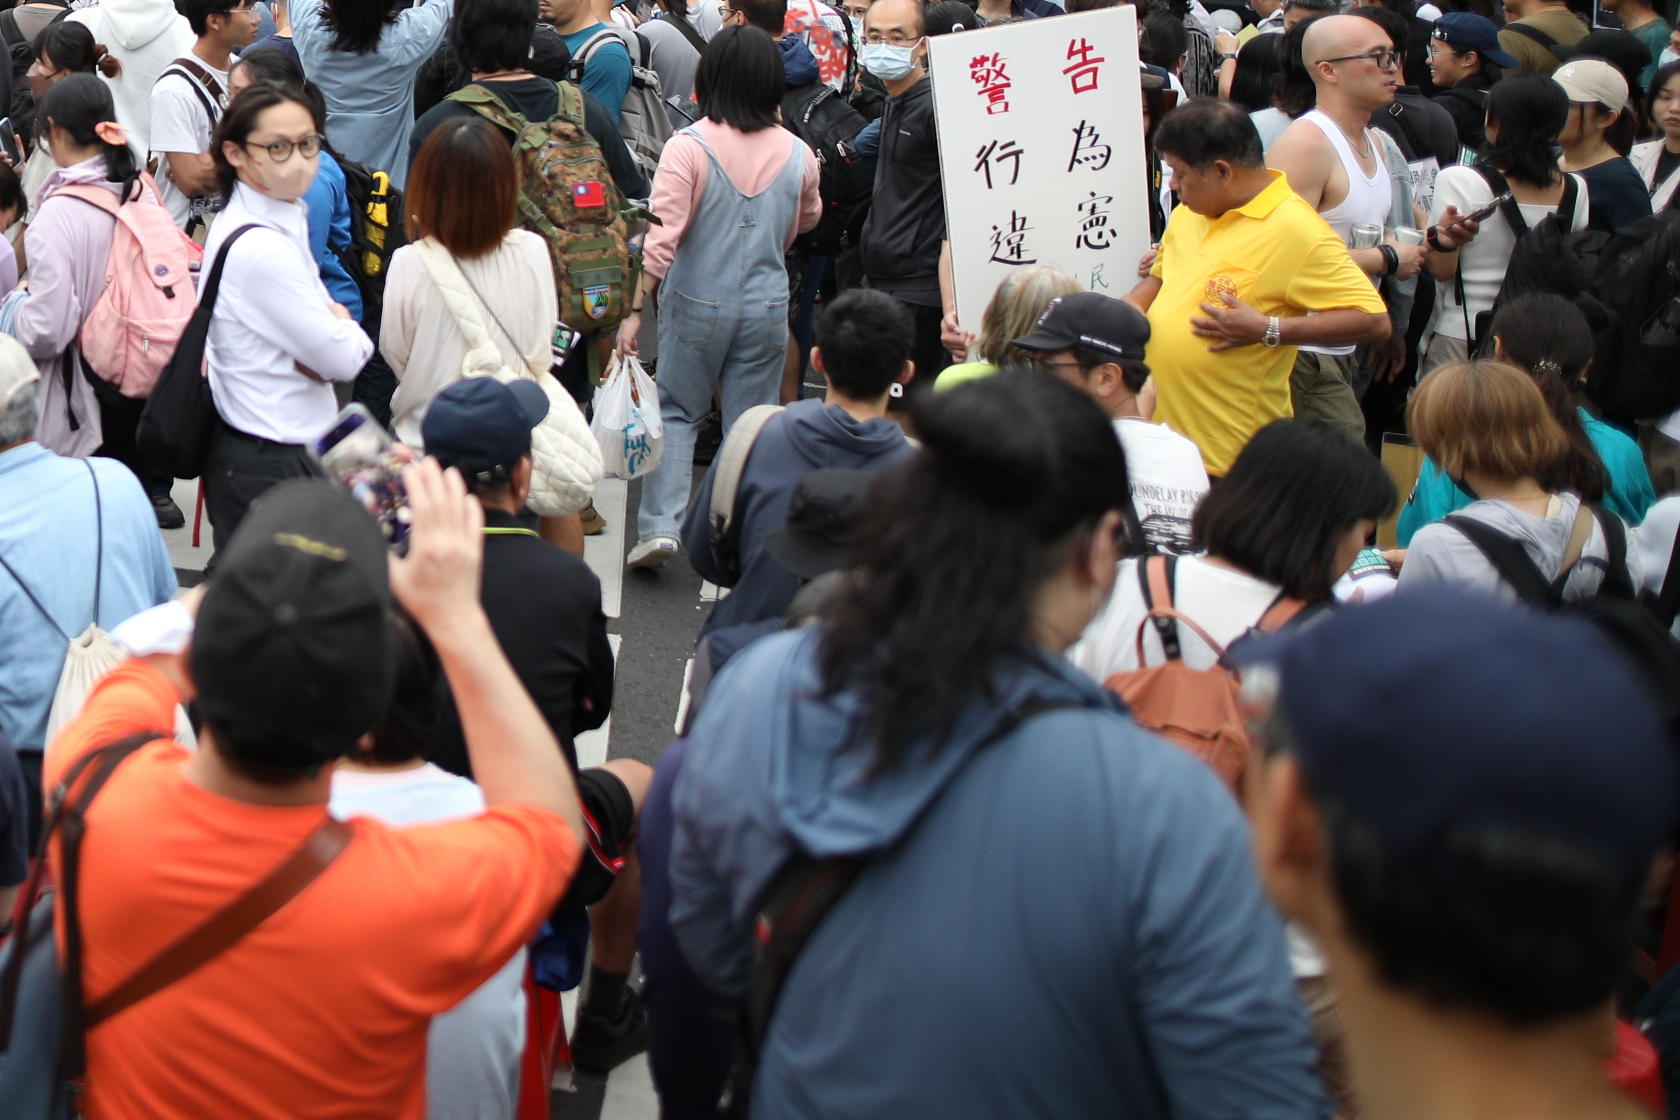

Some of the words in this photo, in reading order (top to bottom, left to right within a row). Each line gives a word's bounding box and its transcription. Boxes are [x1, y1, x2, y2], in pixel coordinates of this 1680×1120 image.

[969, 37, 1106, 116] 警告
[973, 119, 1112, 189] 行為
[987, 191, 1117, 266] 違憲
